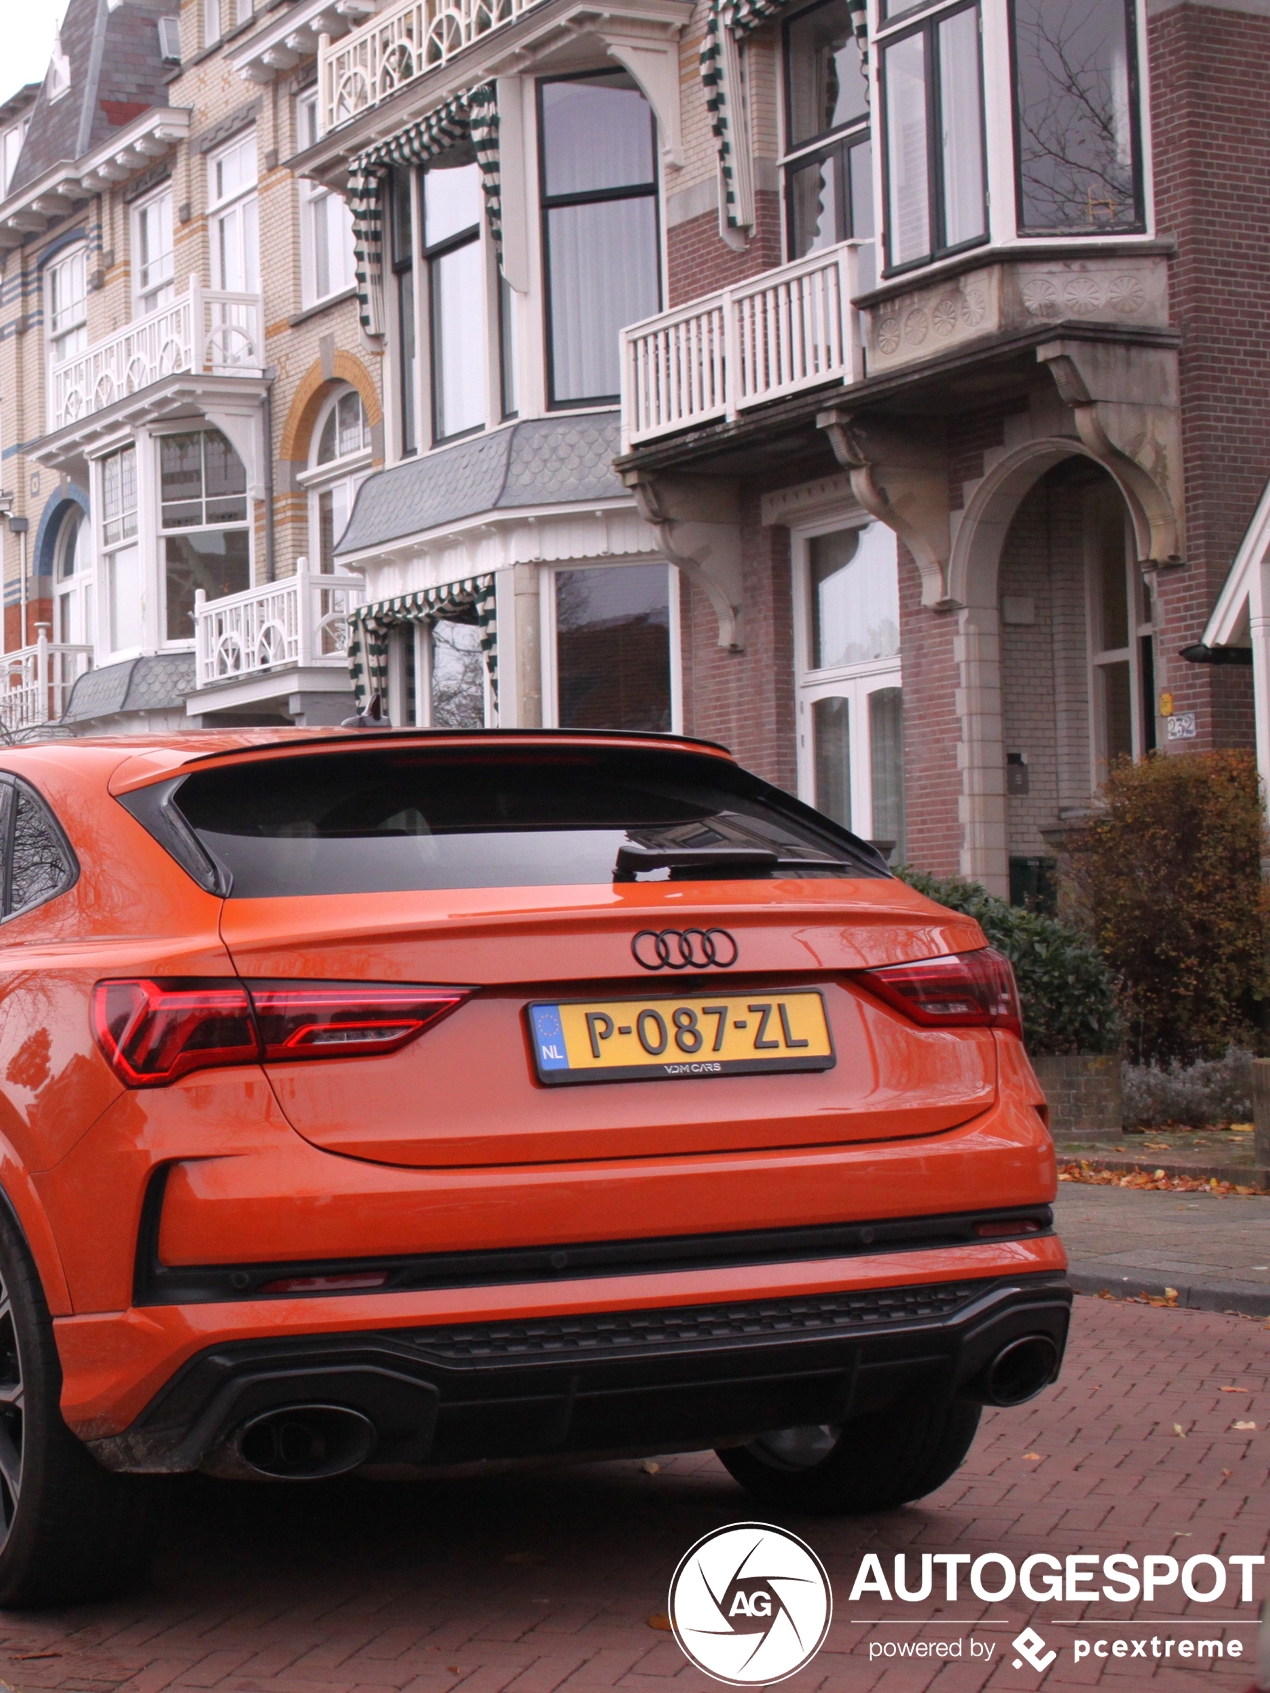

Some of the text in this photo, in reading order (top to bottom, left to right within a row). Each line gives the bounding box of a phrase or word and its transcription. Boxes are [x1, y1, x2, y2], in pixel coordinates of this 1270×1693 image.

[1168, 716, 1194, 737] 232
[585, 1002, 809, 1059] P-087-ZL
[542, 1045, 563, 1061] NL
[664, 1062, 721, 1074] VDM CARS
